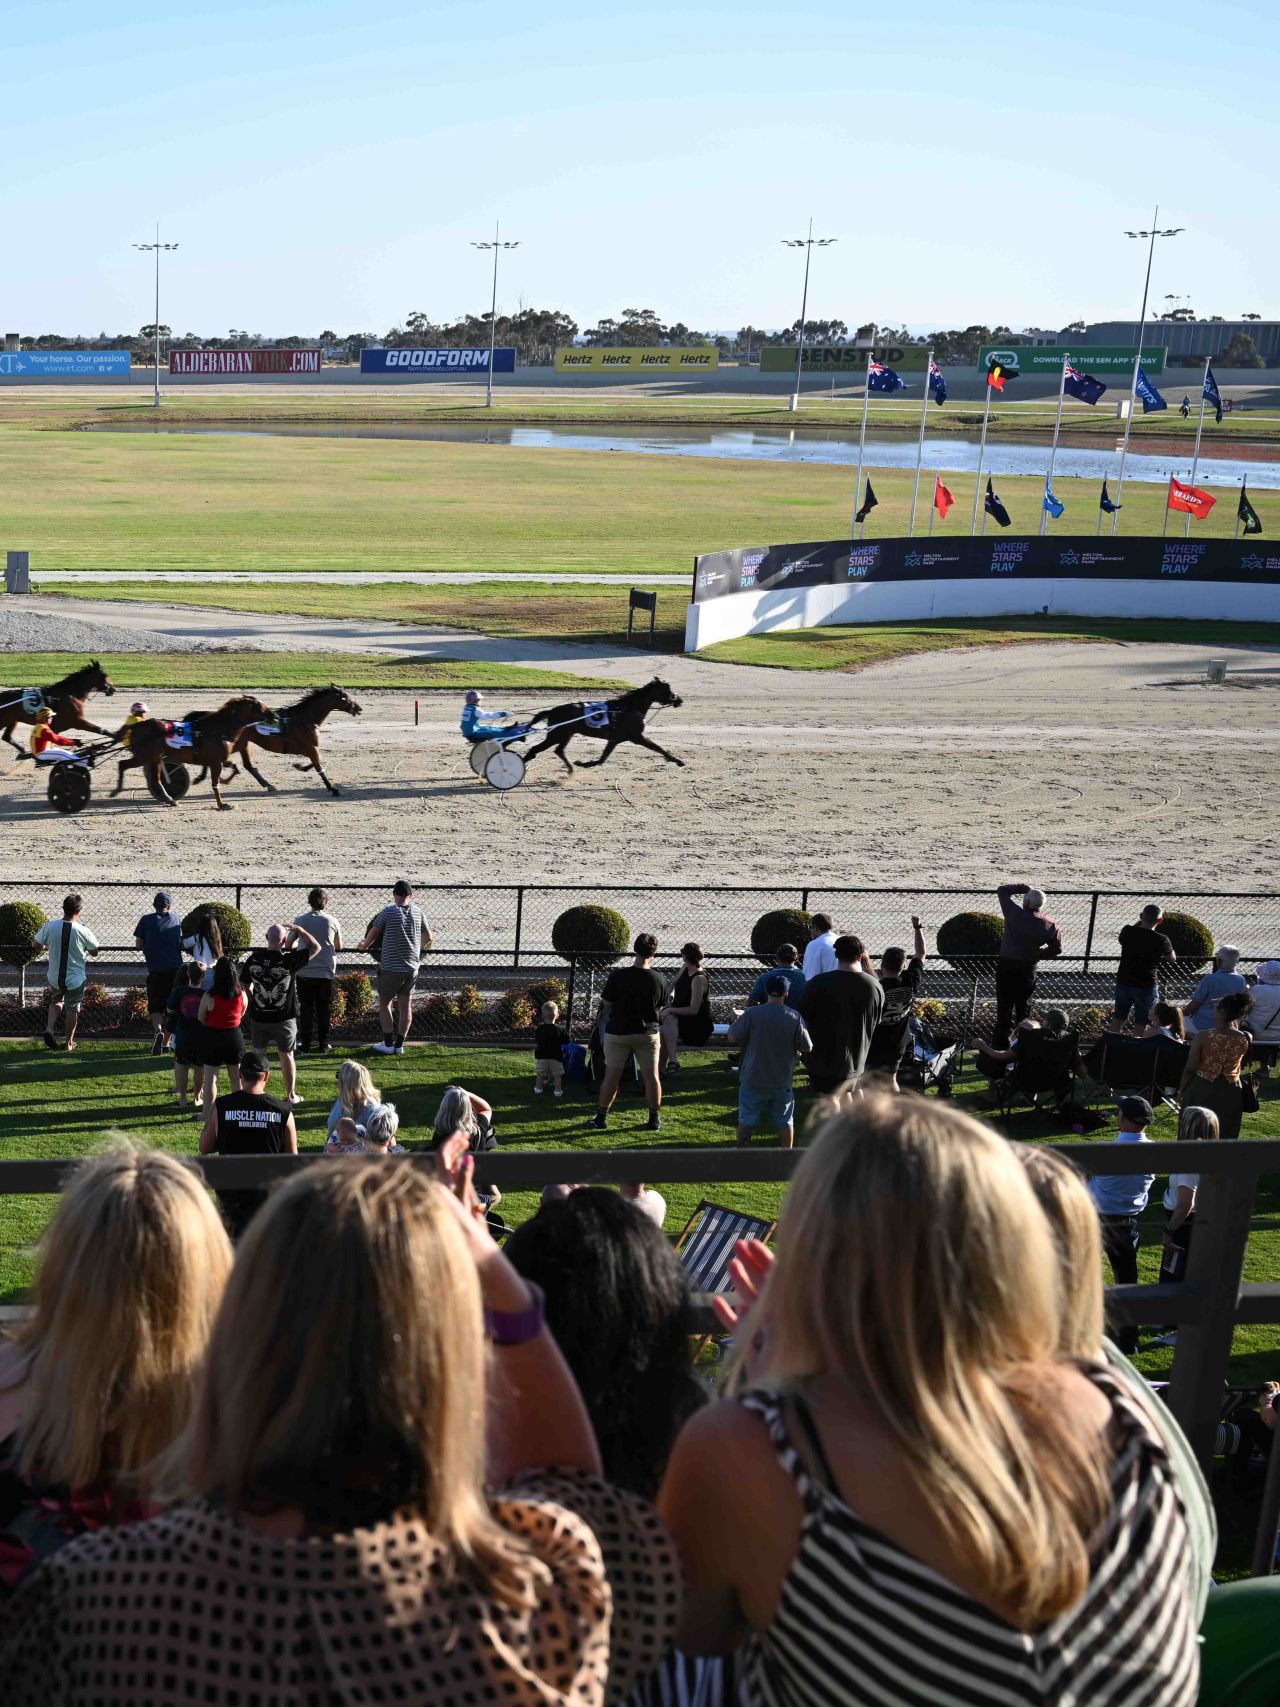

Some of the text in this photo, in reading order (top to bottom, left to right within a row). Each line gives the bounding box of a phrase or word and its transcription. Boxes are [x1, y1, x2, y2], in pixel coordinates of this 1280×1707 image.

[30, 355, 127, 365] Your horse. Our passion.
[385, 350, 491, 366] GOODFORM
[563, 355, 593, 364] Hertz
[601, 355, 632, 364] Hertz
[640, 355, 671, 364] Hertz
[680, 355, 711, 364] Hertz
[850, 545, 880, 556] WHERE
[994, 542, 1029, 552] WHERE
[1165, 544, 1206, 554] WHERE
[742, 554, 764, 566] WHERE
[848, 556, 875, 566] STARS
[992, 552, 1023, 562] STARS
[1162, 554, 1199, 564] STARS
[741, 565, 760, 576] STARS
[847, 566, 868, 577] PLAY
[991, 562, 1015, 572] PLAY
[1161, 564, 1189, 574] PLAY
[740, 576, 756, 588] PLAY
[225, 1110, 282, 1123] MUSCLE NATION
[238, 1121, 268, 1129] WORLDWIDE
